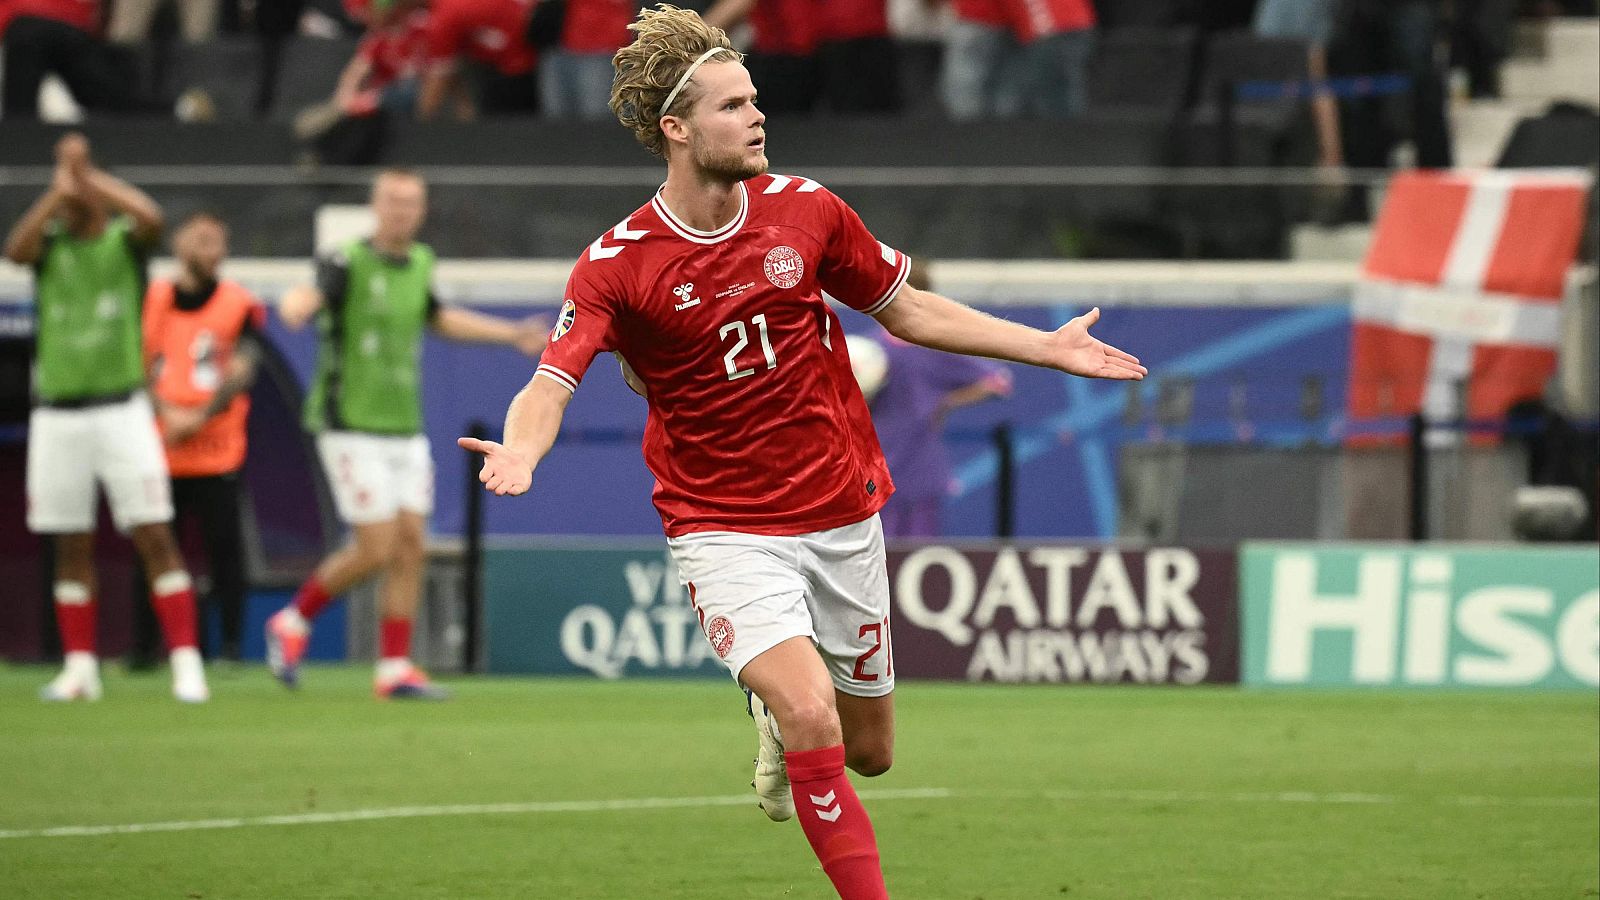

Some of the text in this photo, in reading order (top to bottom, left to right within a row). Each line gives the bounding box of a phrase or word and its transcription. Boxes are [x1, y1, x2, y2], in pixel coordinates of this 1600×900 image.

[772, 258, 797, 275] DBU
[674, 296, 701, 312] hummel
[718, 313, 777, 381] 21
[896, 545, 1205, 646] QATAR
[560, 603, 728, 678] QAT
[712, 625, 728, 648] DBU
[967, 630, 1210, 685] AIRWAYS
